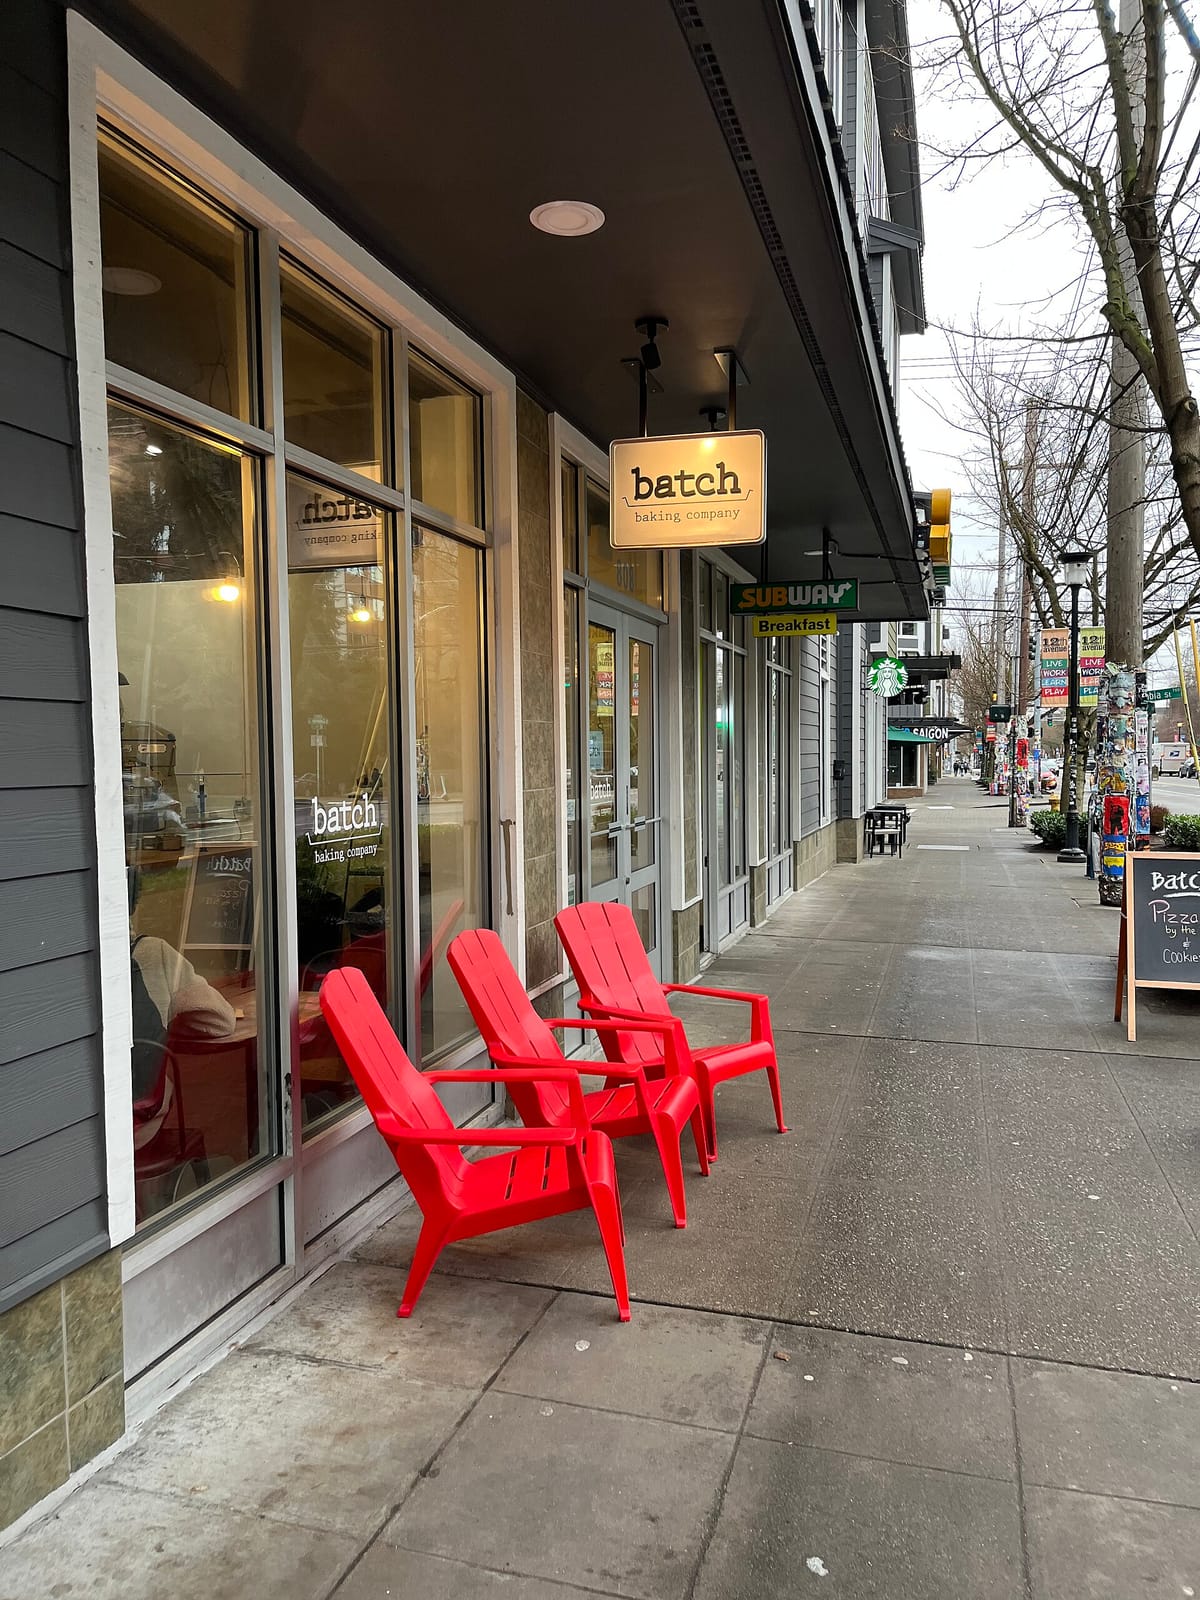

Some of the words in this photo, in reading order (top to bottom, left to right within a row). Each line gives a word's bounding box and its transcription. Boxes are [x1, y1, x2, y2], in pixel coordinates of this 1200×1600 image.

[631, 461, 741, 500] batch
[635, 510, 681, 523] baking
[686, 508, 740, 521] company
[738, 582, 853, 609] SUBWAY
[758, 617, 831, 633] Breakfast
[1043, 637, 1067, 646] 12th
[1085, 658, 1103, 666] LIVE
[1043, 669, 1067, 677] WORK
[1042, 678, 1067, 686] LEARN
[1081, 677, 1100, 686] LEAR
[1164, 690, 1172, 698] St
[912, 727, 949, 739] SAIGON
[312, 792, 377, 835] batch
[314, 848, 345, 863] baking
[347, 845, 377, 859] company
[1148, 899, 1199, 924] Pizza
[1165, 925, 1177, 938] by
[1181, 924, 1197, 935] the
[1163, 948, 1200, 964] Cookie
